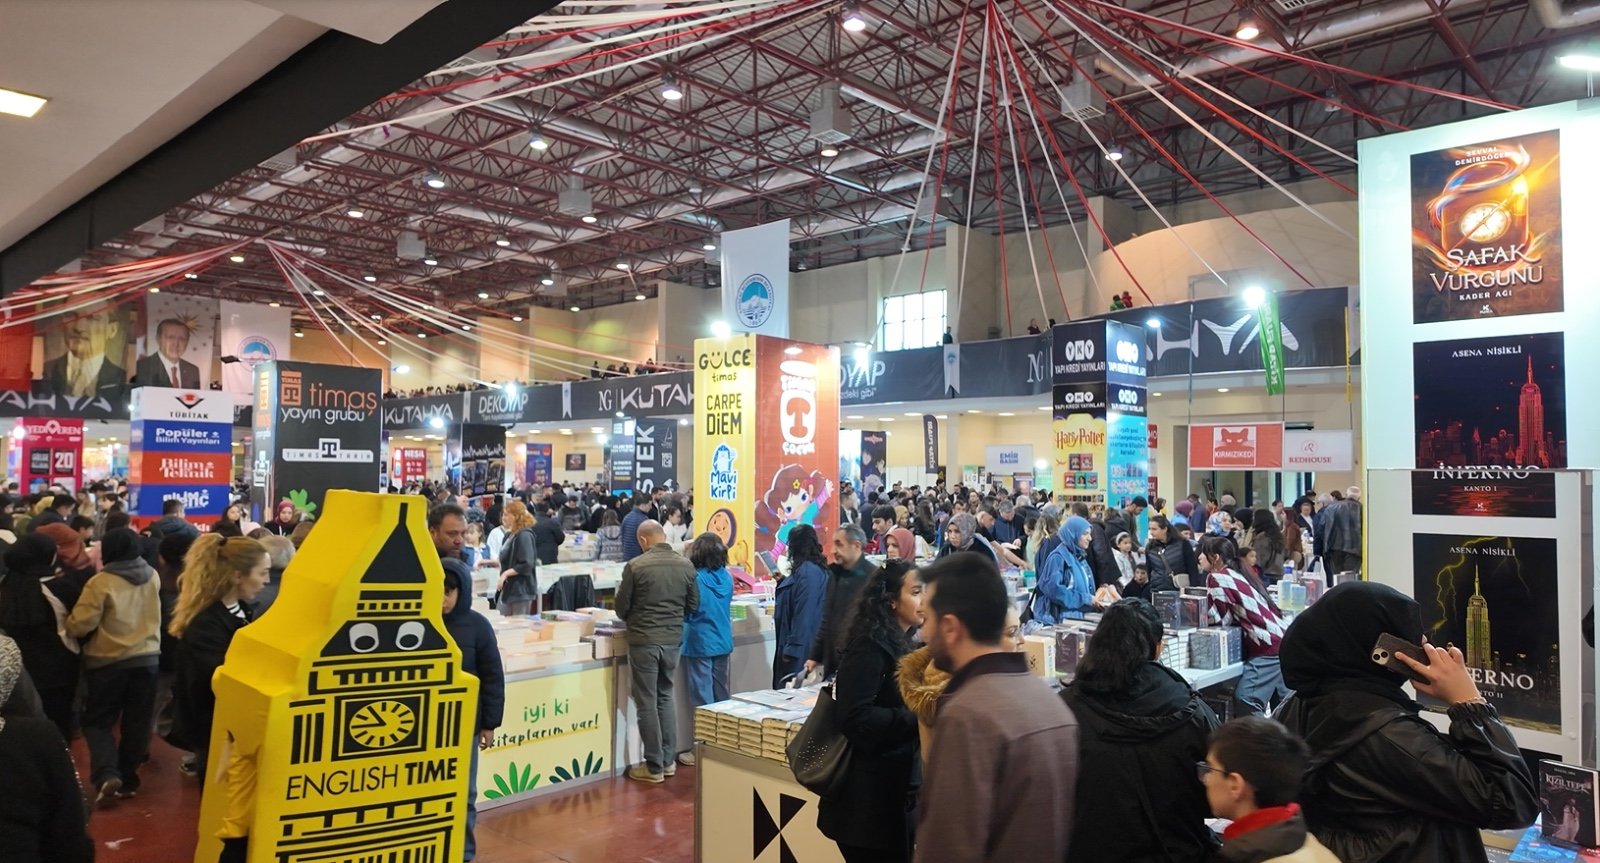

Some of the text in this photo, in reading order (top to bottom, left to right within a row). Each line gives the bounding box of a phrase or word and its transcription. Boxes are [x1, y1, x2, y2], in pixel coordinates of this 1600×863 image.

[1430, 265, 1545, 292] VURGUNU
[1459, 291, 1491, 301] KADER
[1146, 313, 1300, 362] HYA
[698, 349, 752, 371] GÜLCE
[1451, 348, 1483, 358] ASENA
[1055, 364, 1066, 374] YAPI
[1080, 362, 1106, 373] YAYINLARI
[309, 383, 378, 417] timaş
[706, 393, 742, 411] CARPE
[170, 411, 209, 419] TÜBİTAK
[280, 405, 365, 425] yayın grubu
[155, 427, 209, 441] Popüler
[155, 436, 180, 444] Bilim
[1056, 429, 1079, 450] Harry
[1078, 427, 1105, 447] Potter
[54, 452, 74, 469] 20
[999, 450, 1019, 459] EMİR
[1288, 456, 1332, 464] REDHOUSE
[710, 470, 737, 485] Mavi
[1449, 546, 1478, 555] ASENA
[1466, 667, 1534, 690] ERNO
[523, 698, 569, 723] iyi ki
[571, 713, 599, 731] var!
[286, 757, 458, 801] ENGLISH TIME
